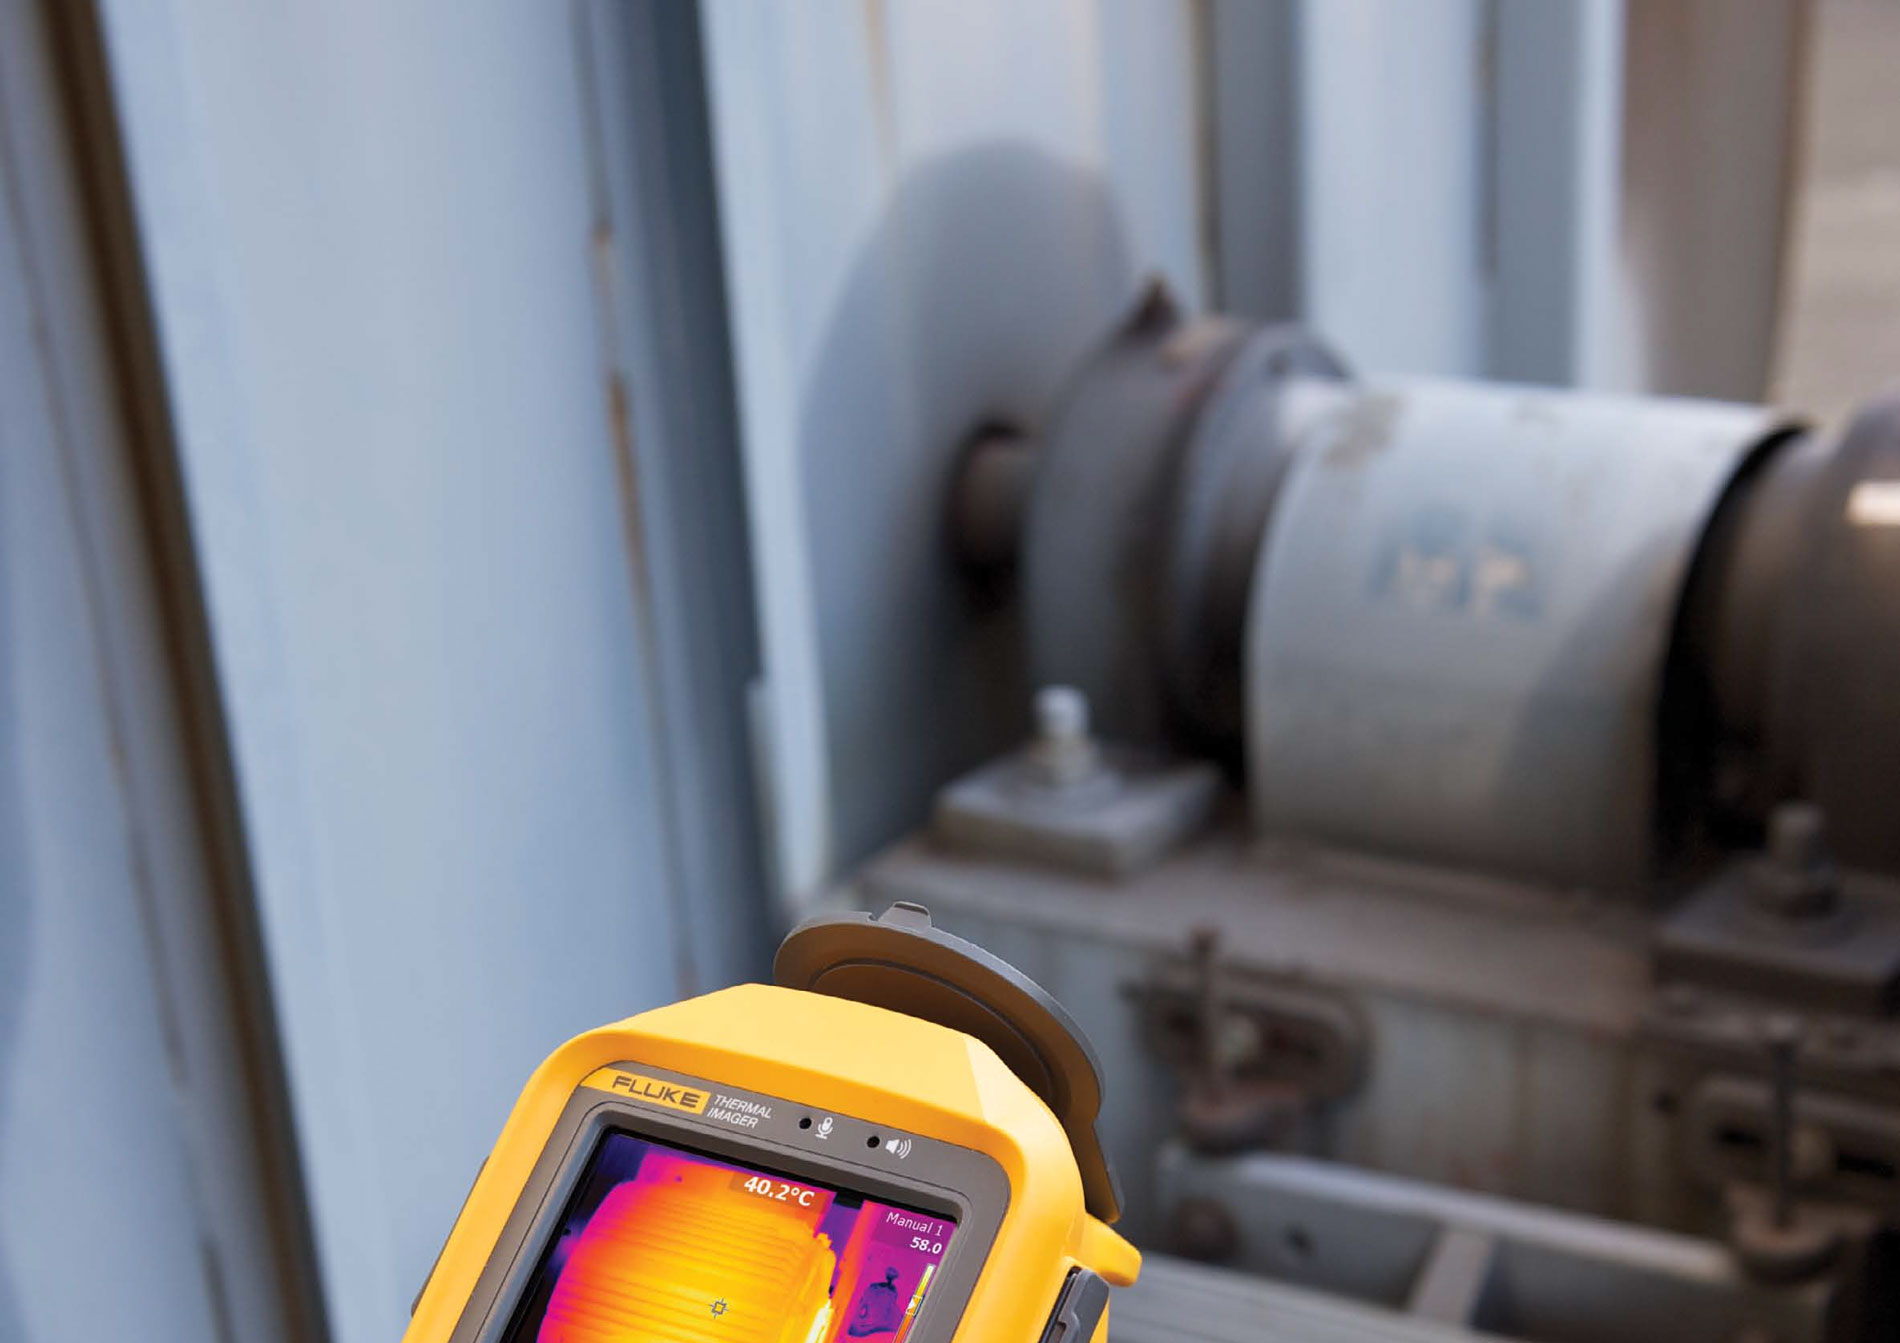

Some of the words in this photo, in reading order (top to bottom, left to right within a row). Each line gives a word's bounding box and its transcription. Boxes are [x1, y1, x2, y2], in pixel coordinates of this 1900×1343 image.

[612, 1075, 701, 1108] FLUKE
[707, 1107, 759, 1129] IMAGER
[714, 1094, 773, 1119] THERMAL
[744, 1176, 815, 1207] 40.2°C
[886, 1212, 934, 1234] Manual
[934, 1225, 943, 1237] 1
[910, 1236, 943, 1255] 58.0
